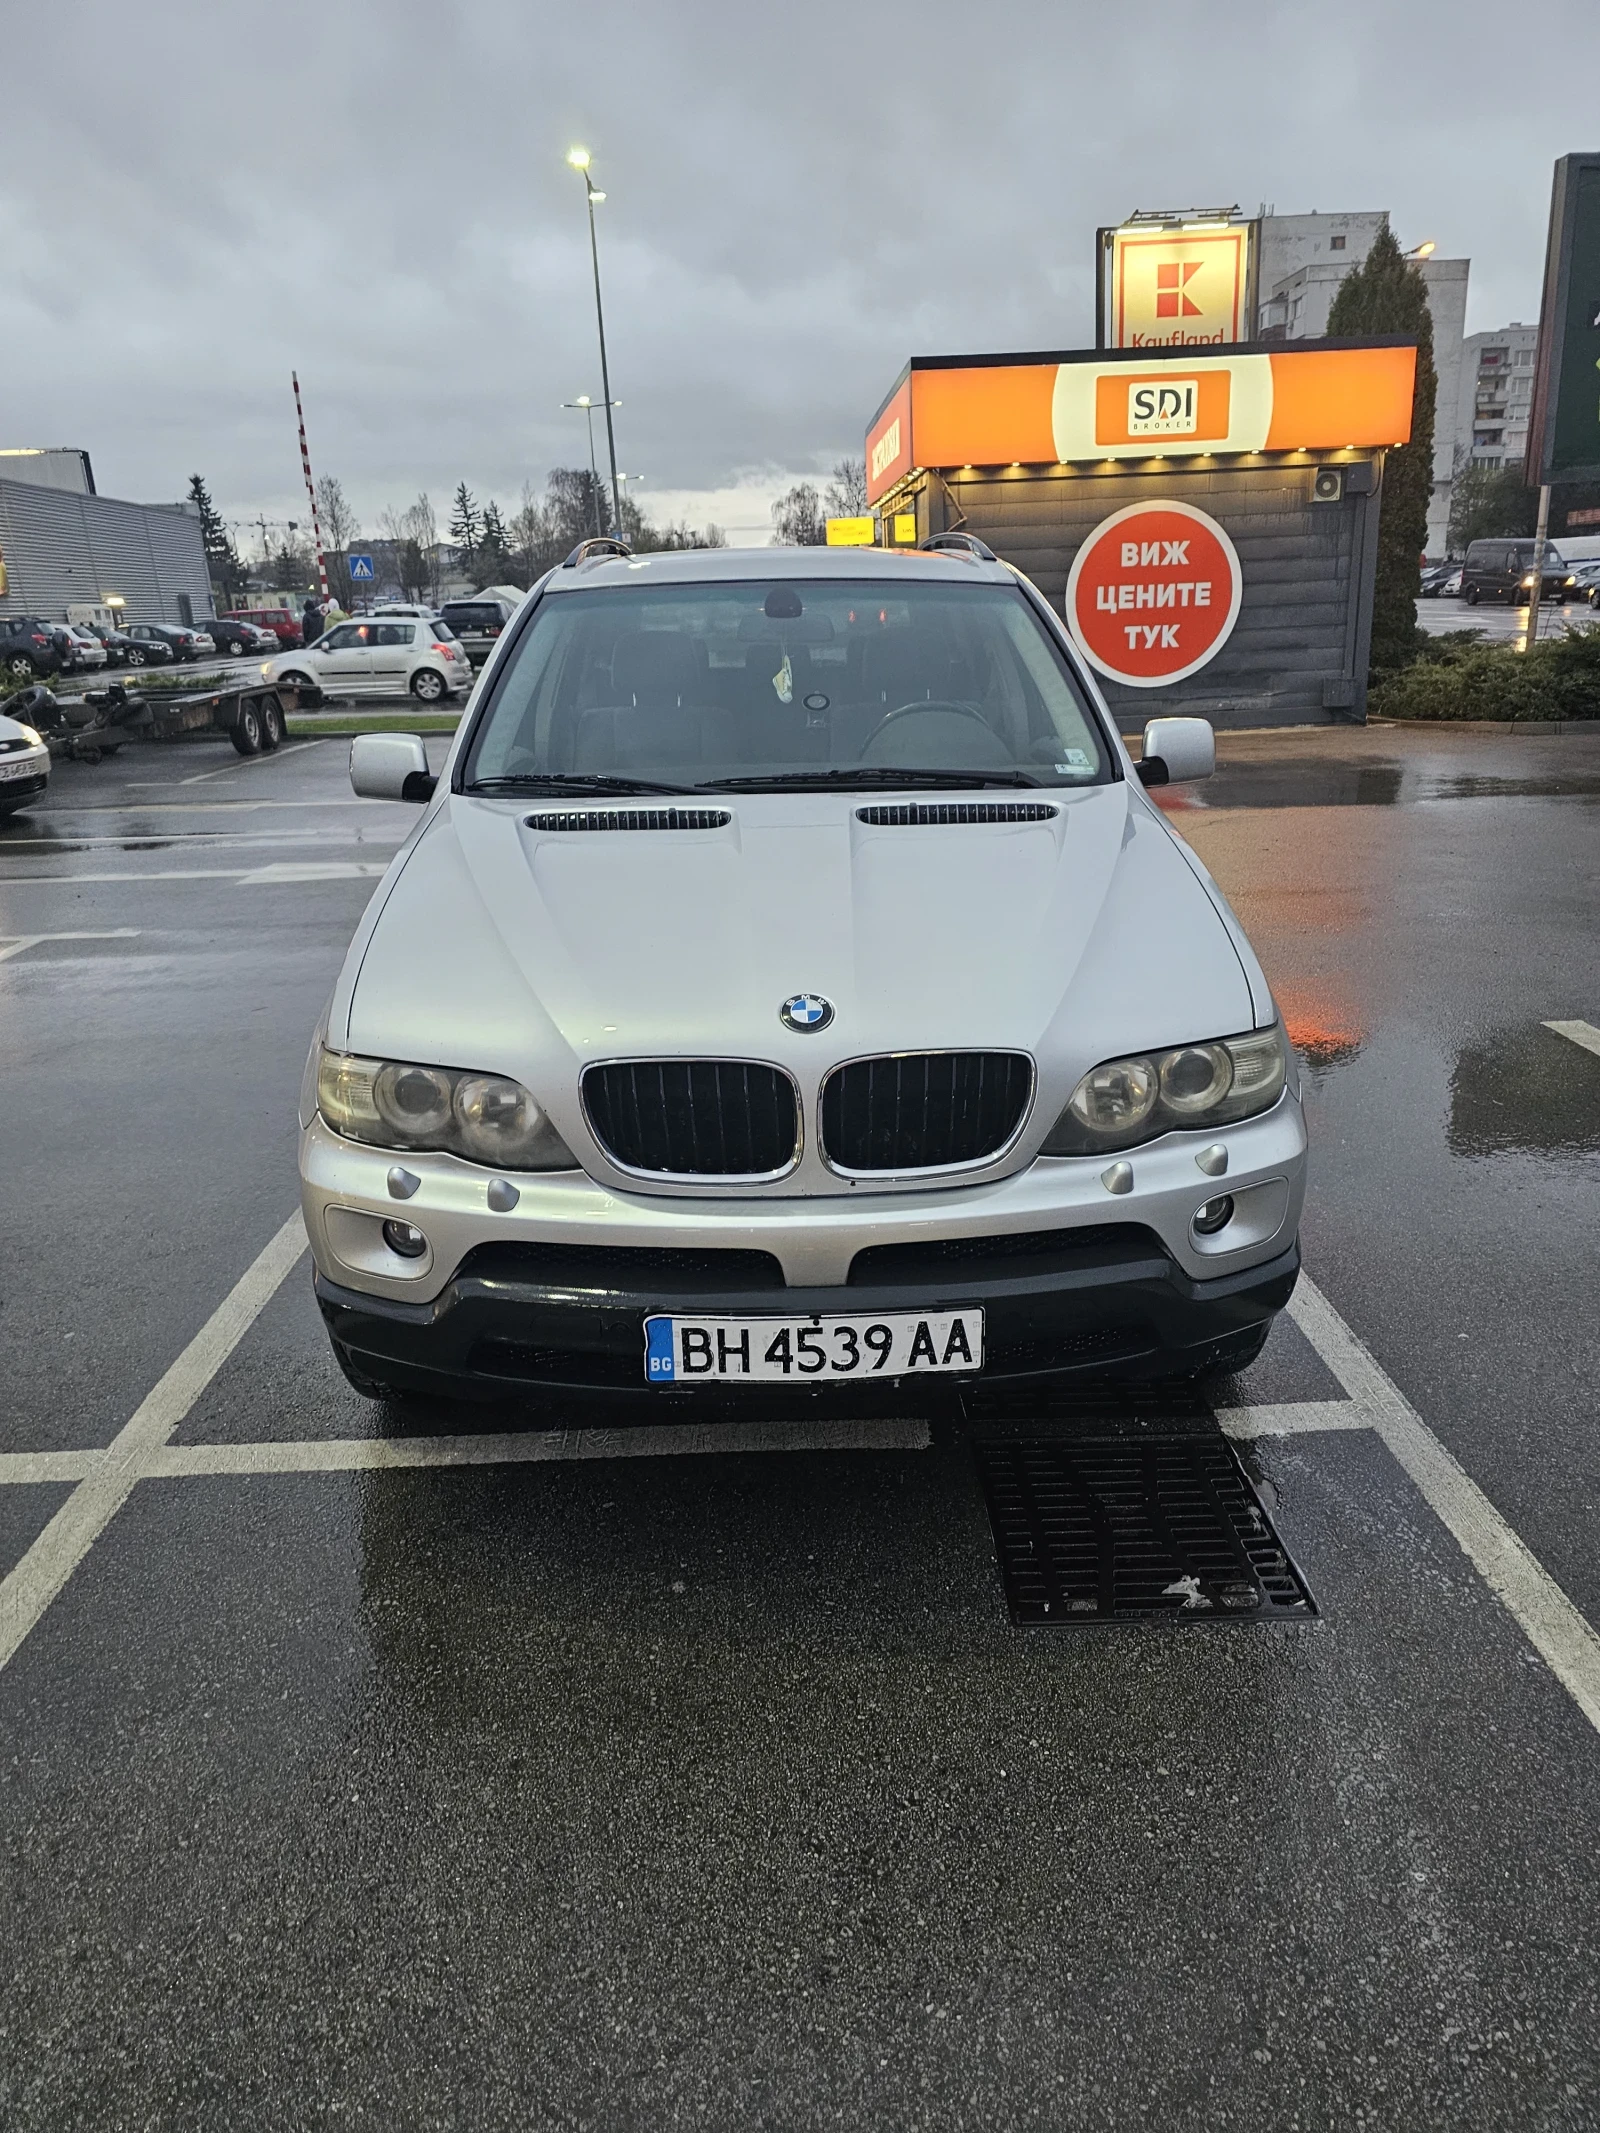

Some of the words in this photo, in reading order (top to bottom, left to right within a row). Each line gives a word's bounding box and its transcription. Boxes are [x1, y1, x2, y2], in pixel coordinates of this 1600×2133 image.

[1132, 327, 1224, 348] Kaufland
[1134, 387, 1192, 421] SDI
[1133, 420, 1191, 430] BROKER
[1120, 539, 1190, 568] ВИЖ
[1096, 581, 1212, 613] ЦЕНИТЕ
[1123, 623, 1180, 651] ТУК
[785, 994, 827, 1006] BMW
[681, 1327, 751, 1374] BH
[764, 1323, 894, 1374] 4539
[907, 1318, 973, 1368] AA
[650, 1356, 673, 1372] BG
